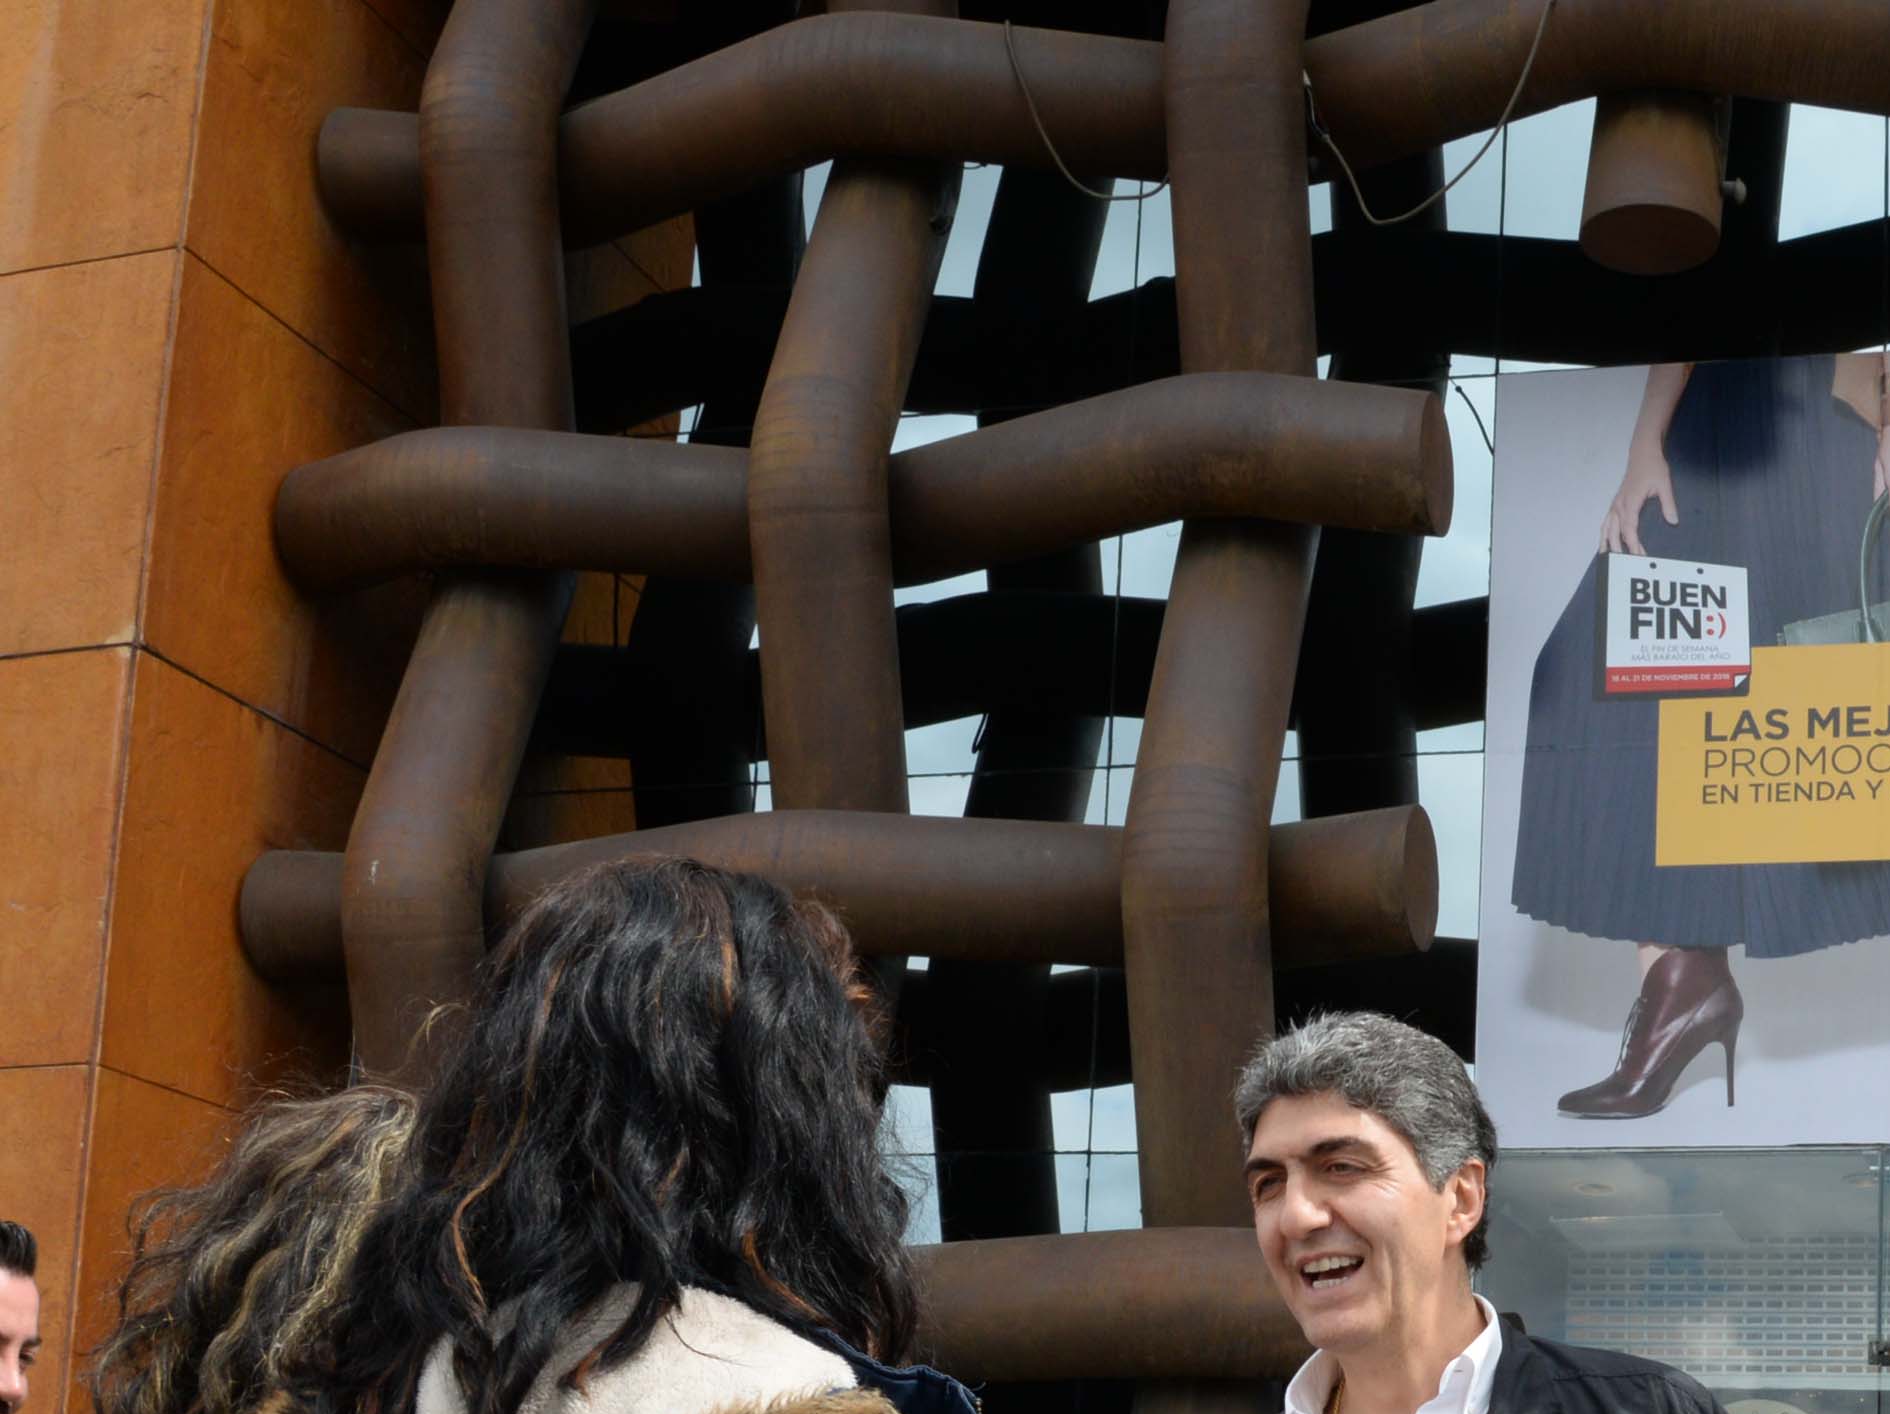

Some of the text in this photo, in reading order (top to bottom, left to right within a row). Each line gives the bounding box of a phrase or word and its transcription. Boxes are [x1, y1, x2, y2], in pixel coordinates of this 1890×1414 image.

[1630, 577, 1727, 609] BUEN
[1704, 708, 1790, 742] LAS
[1702, 783, 1739, 804] EN
[1749, 780, 1856, 803] TIENDA
[1866, 779, 1884, 800] Y
